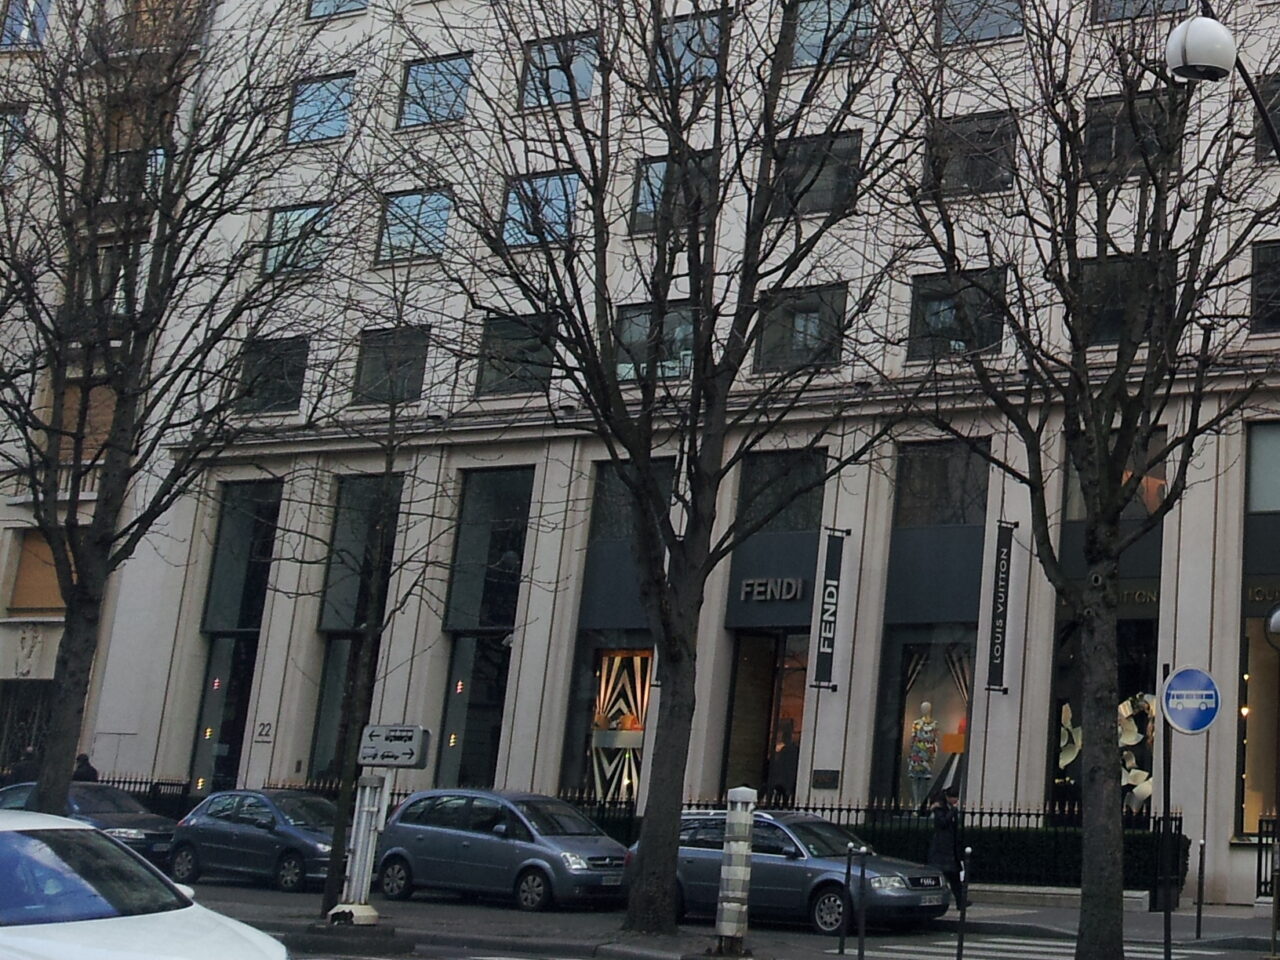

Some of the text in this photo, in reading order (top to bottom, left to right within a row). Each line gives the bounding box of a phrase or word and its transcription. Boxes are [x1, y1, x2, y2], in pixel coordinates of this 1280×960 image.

[740, 578, 803, 600] FENDI
[994, 548, 1008, 663] LOUIS VUITTON
[819, 579, 838, 653] FENDI
[258, 723, 272, 736] 22
